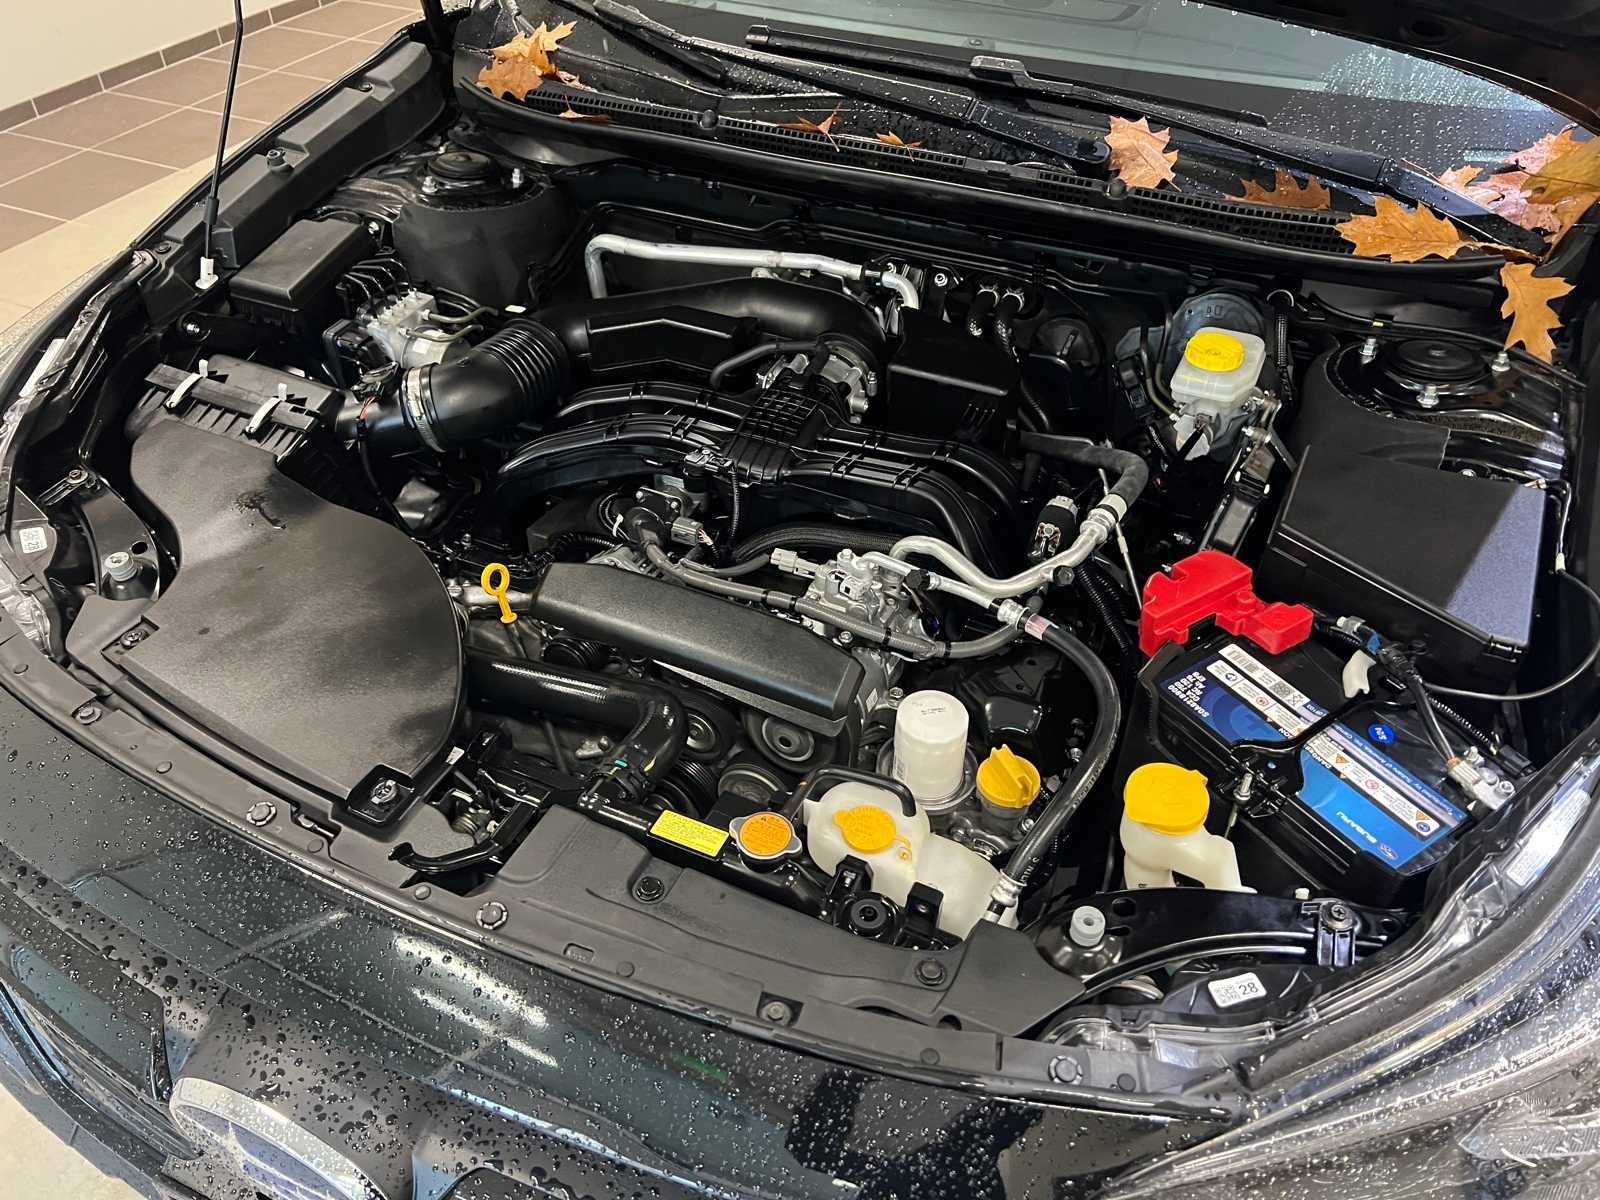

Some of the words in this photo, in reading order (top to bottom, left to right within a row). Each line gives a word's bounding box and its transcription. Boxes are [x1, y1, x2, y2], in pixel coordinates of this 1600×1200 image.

[1185, 689, 1200, 702] CCA
[1336, 811, 1378, 844] SUBARU
[1238, 981, 1259, 996] 28
